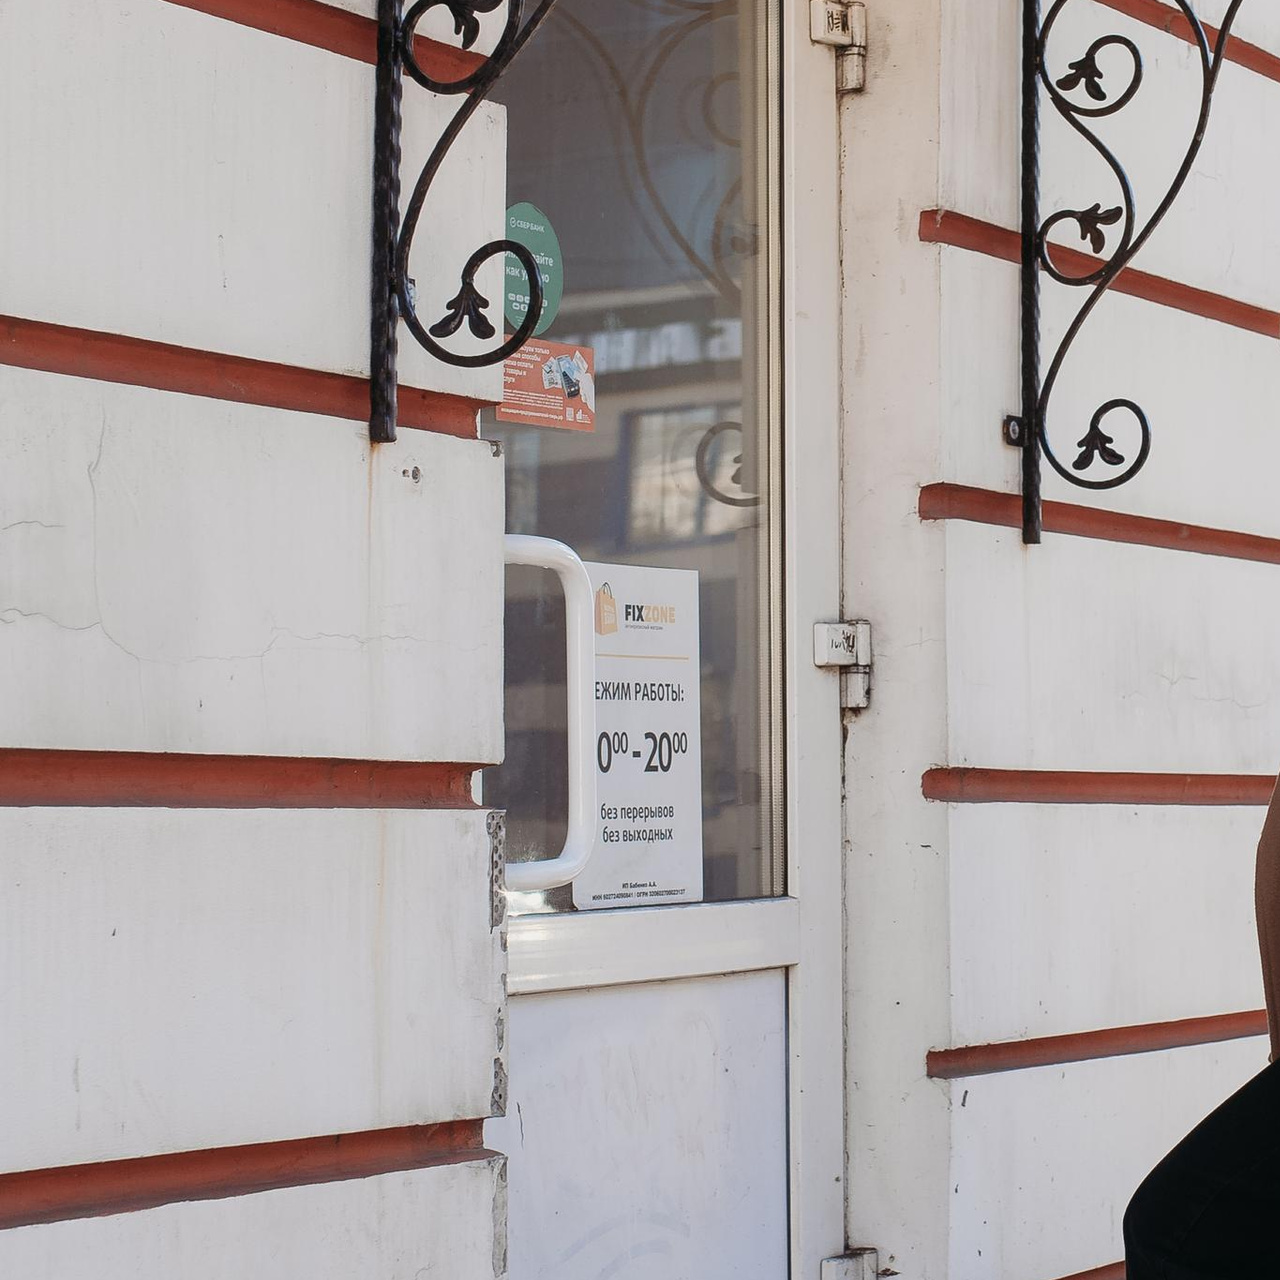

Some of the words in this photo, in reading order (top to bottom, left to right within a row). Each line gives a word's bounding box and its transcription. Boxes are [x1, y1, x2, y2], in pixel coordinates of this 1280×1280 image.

[625, 605, 676, 623] FIXZONE
[595, 682, 632, 700] ЕЖИМ
[635, 683, 684, 701] РАБОТЫ:
[600, 803, 618, 820] без
[621, 806, 674, 822] перерывов
[603, 826, 620, 842] без
[622, 828, 673, 843] выходных
